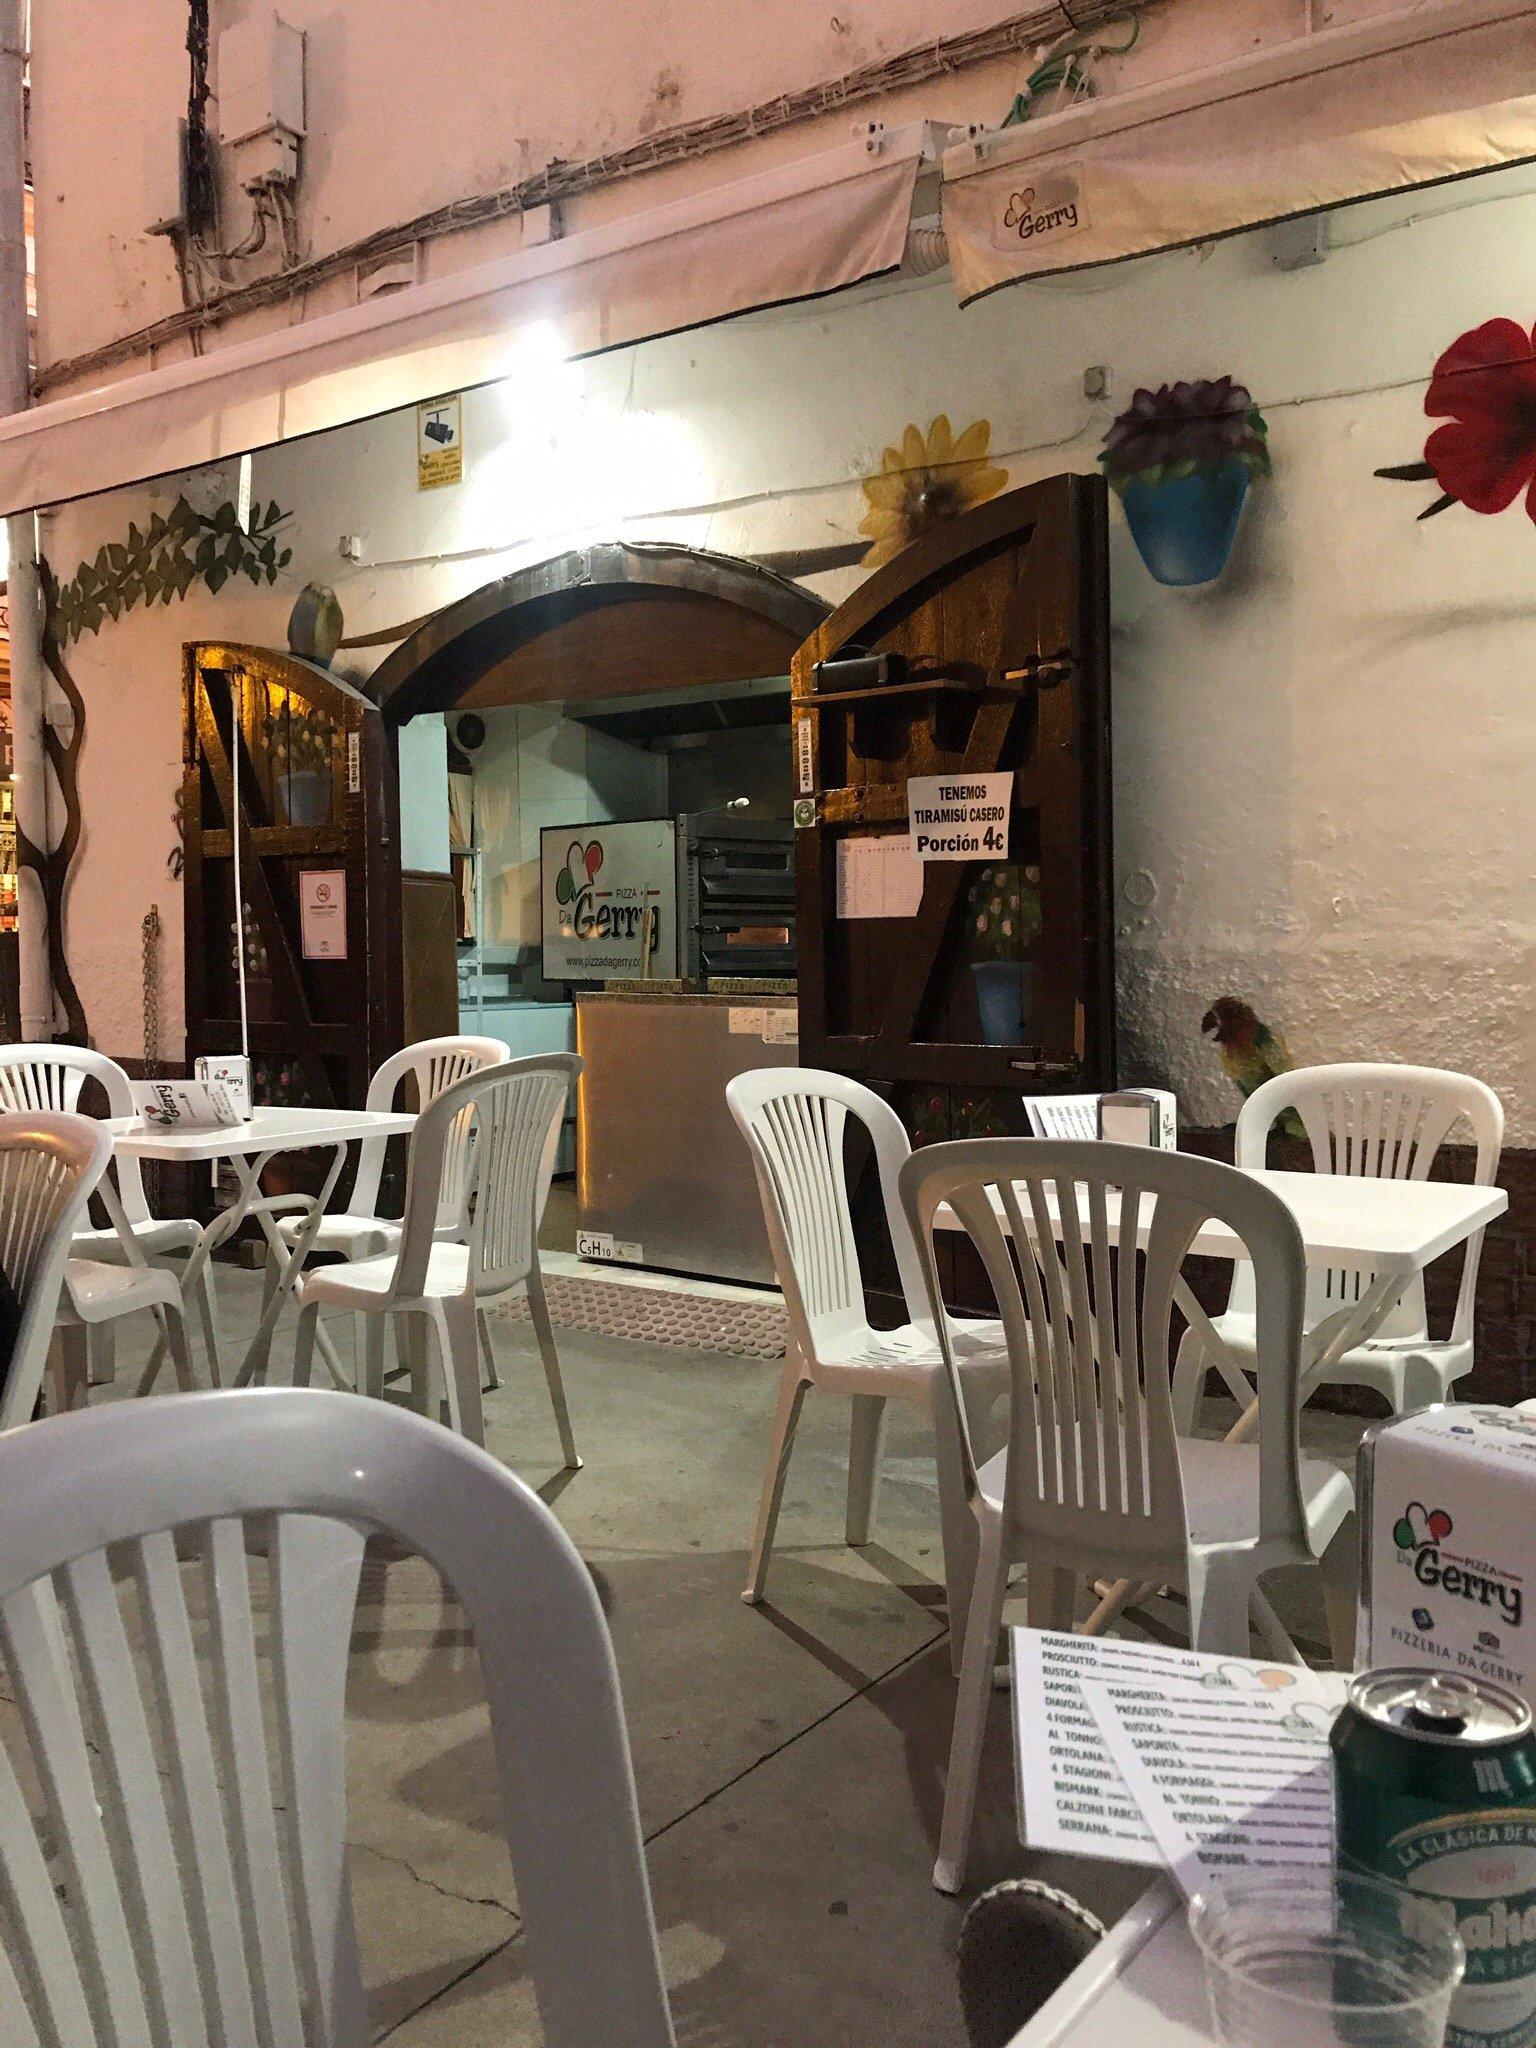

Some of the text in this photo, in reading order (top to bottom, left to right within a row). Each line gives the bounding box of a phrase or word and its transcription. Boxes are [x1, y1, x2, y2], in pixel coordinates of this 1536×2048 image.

[1018, 203, 1078, 239] Gerry
[939, 785, 987, 801] TENEMOS
[914, 804, 1005, 824] TIRAMISÚ CASERO
[917, 833, 979, 853] Porción
[982, 826, 1004, 851] 4€
[615, 888, 638, 899] PIZZA
[574, 884, 660, 955] Gerry
[155, 1085, 180, 1118] Gerry
[1464, 1557, 1498, 1576] PIZZA
[1414, 1548, 1523, 1628] Gerry
[1390, 1626, 1452, 1660] PIZZERIA
[1457, 1651, 1477, 1669] DA
[1480, 1660, 1524, 1686] GERRY
